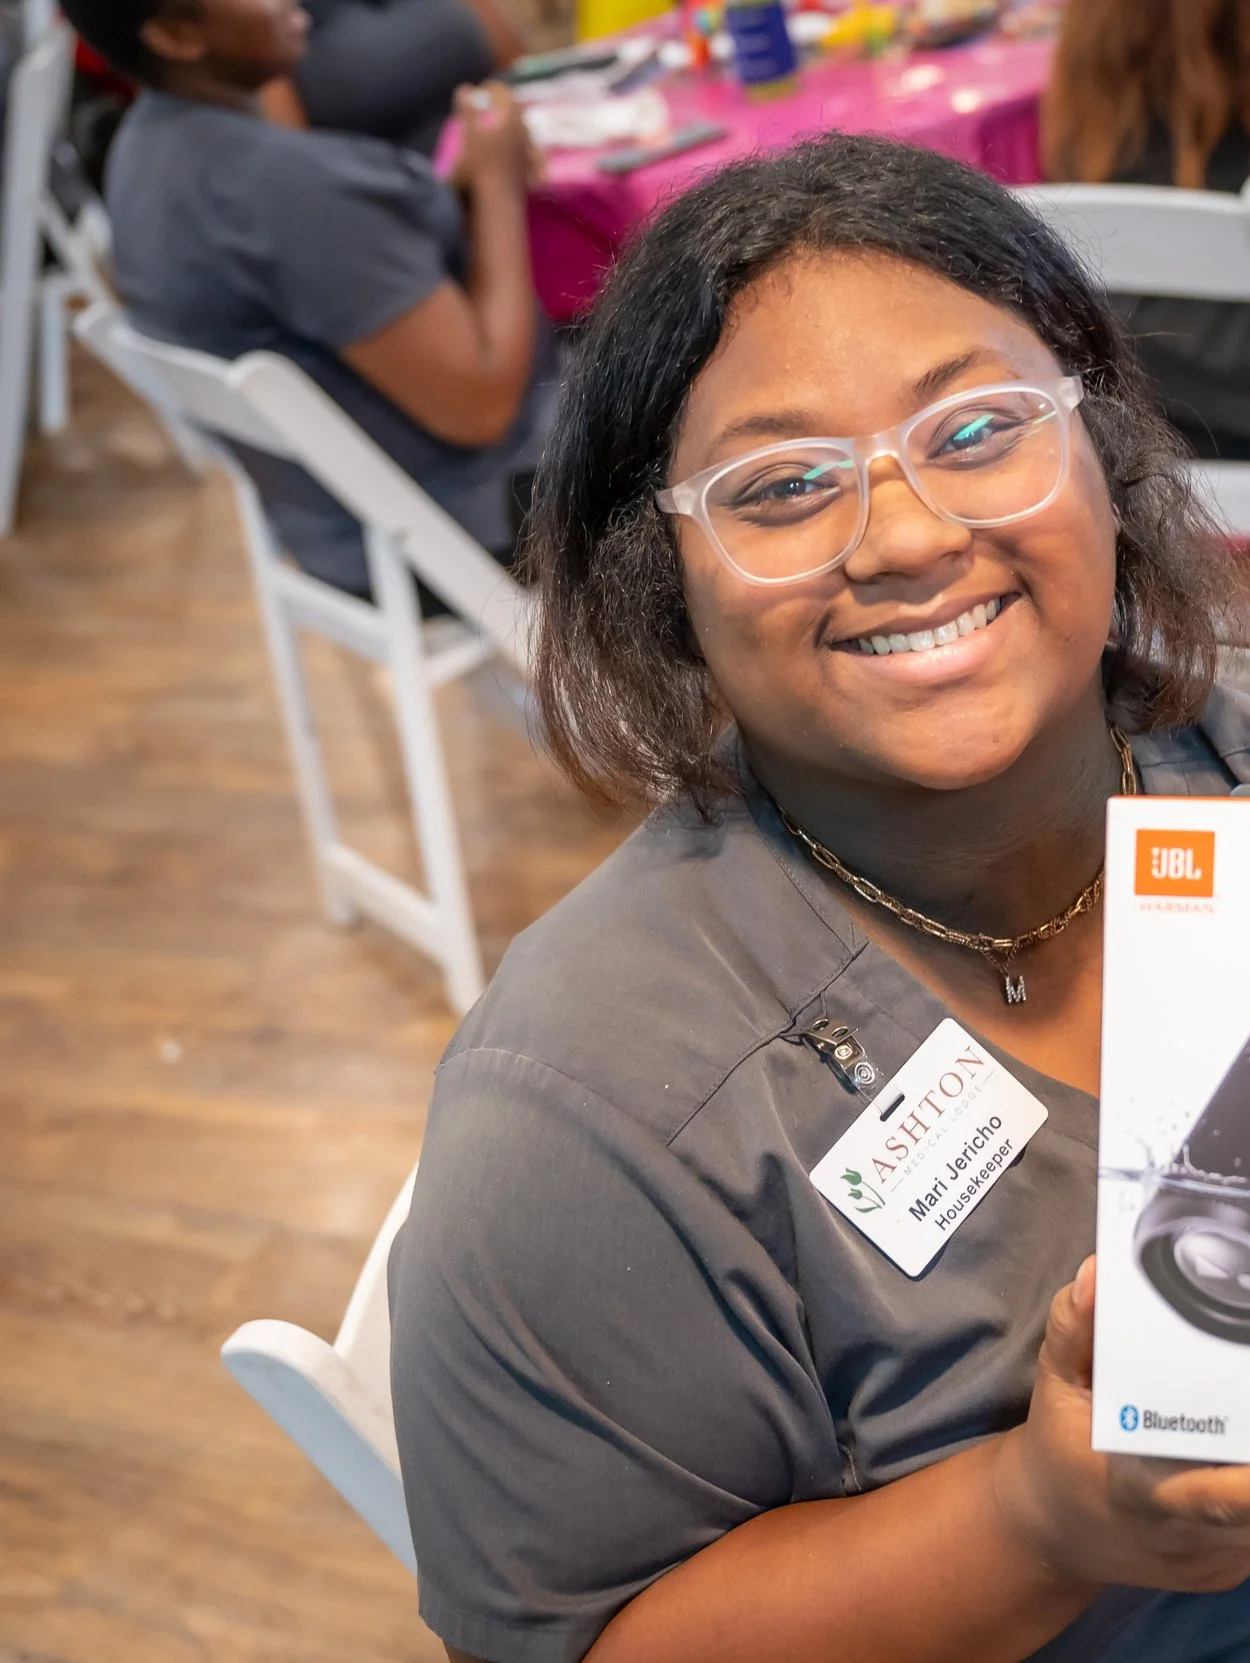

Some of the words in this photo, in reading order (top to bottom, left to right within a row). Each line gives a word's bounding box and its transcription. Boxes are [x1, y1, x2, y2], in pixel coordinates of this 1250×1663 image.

[1151, 847, 1202, 880] JBL
[1005, 975, 1027, 1004] M
[869, 1045, 985, 1184] ASHTON
[903, 1126, 948, 1176] MEDICAL
[950, 1085, 983, 1122] LODGE
[908, 1177, 949, 1222] Mari
[945, 1115, 1002, 1181] Jericho
[934, 1138, 1014, 1232] Housekeeper
[1143, 1409, 1227, 1435] Bluetooth
